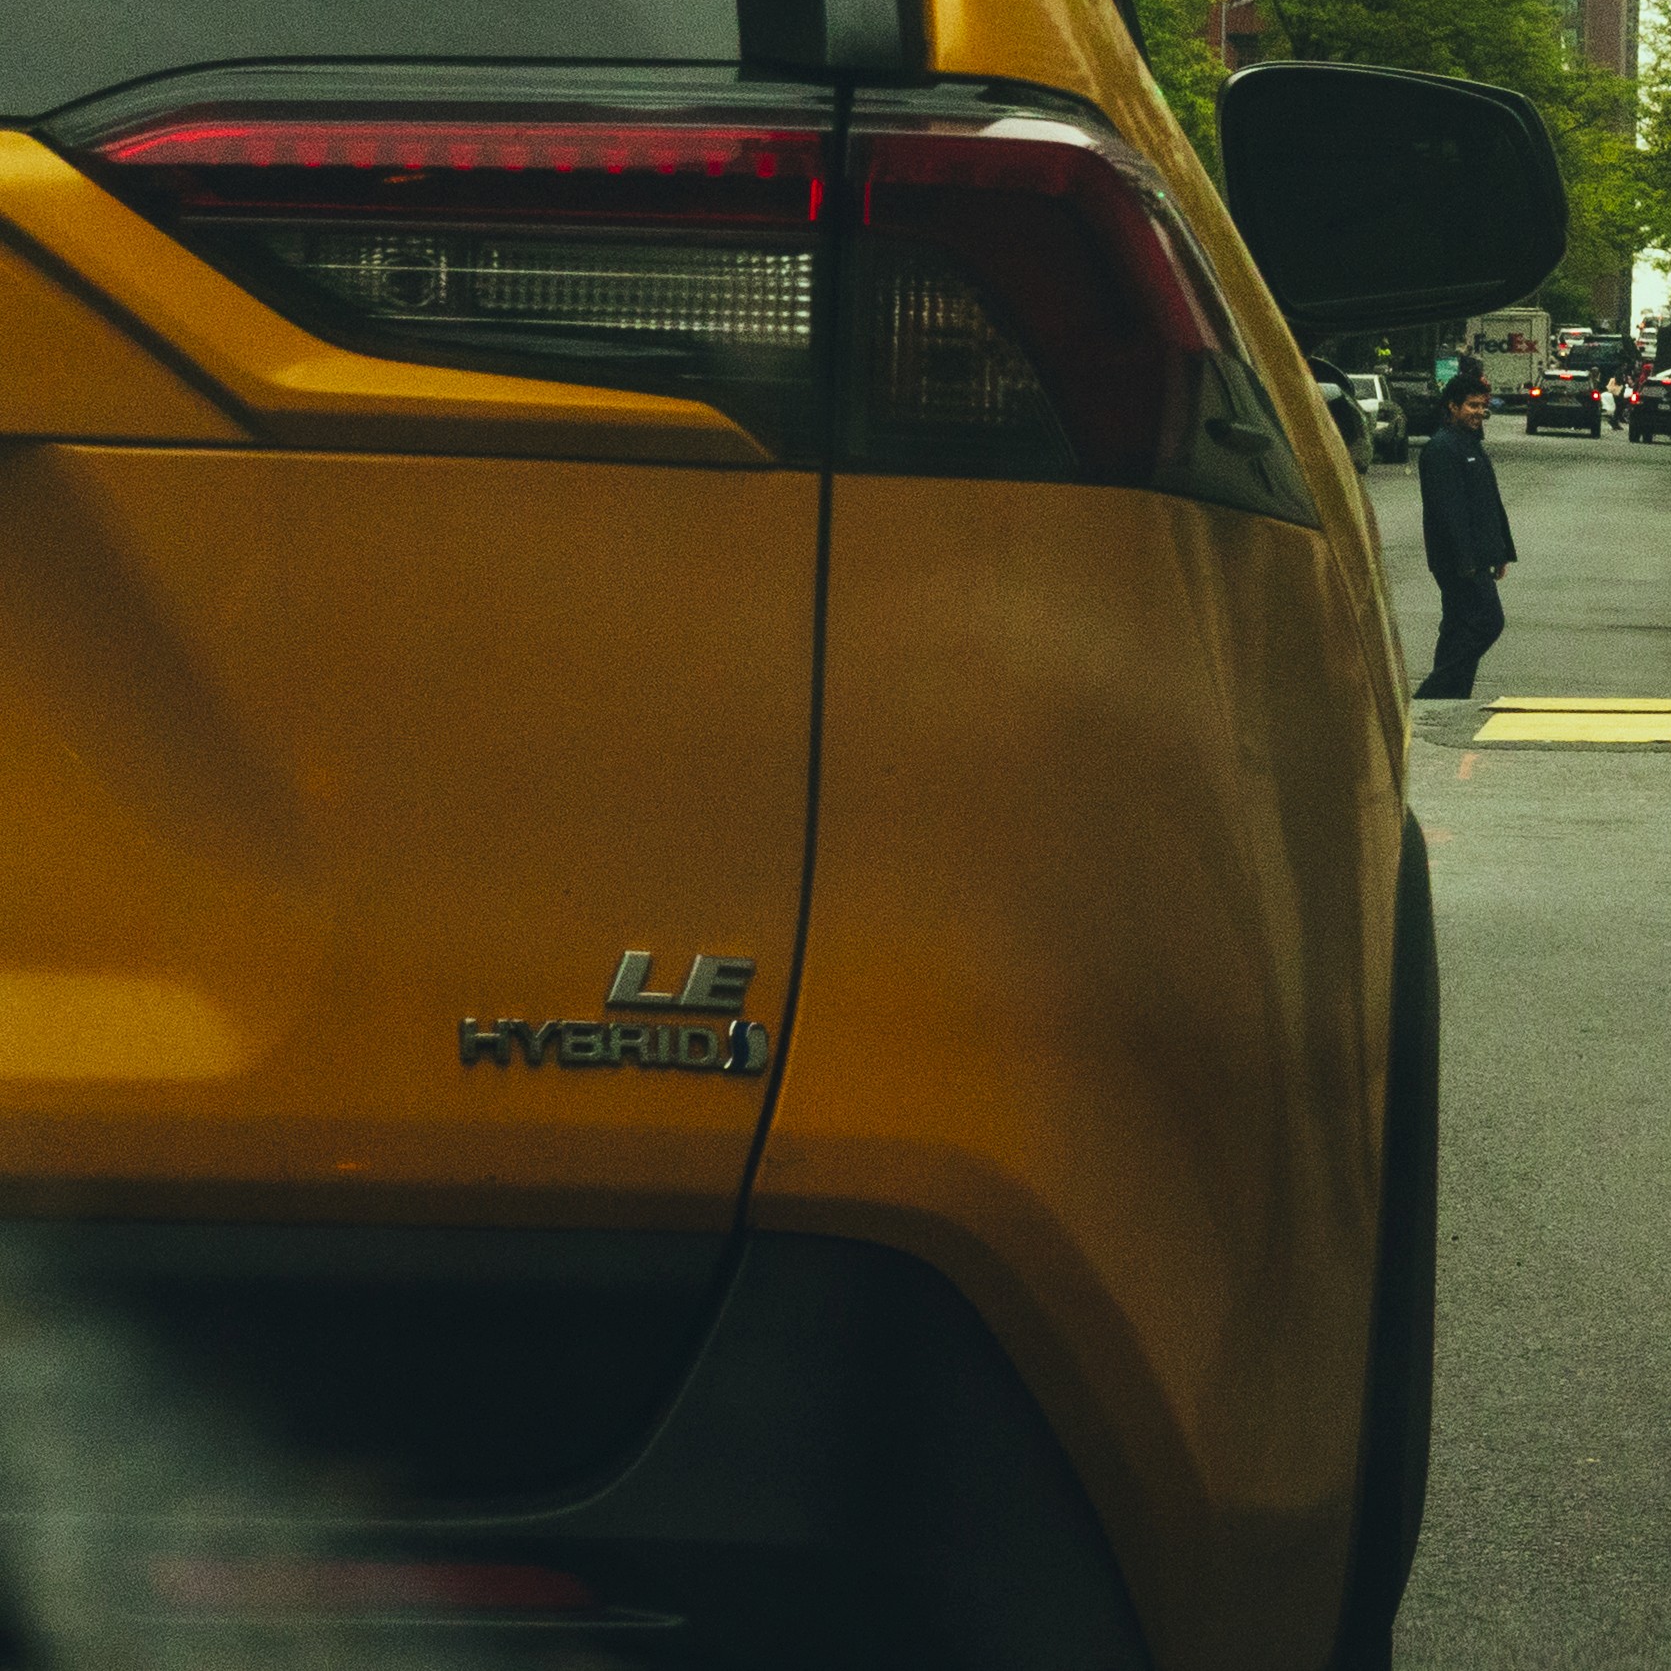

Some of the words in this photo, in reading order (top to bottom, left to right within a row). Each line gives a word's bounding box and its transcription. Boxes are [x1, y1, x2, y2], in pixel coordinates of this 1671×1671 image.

[1473, 332, 1539, 354] FedEx
[605, 950, 756, 1015] LE
[459, 1017, 721, 1069] HYBRID
